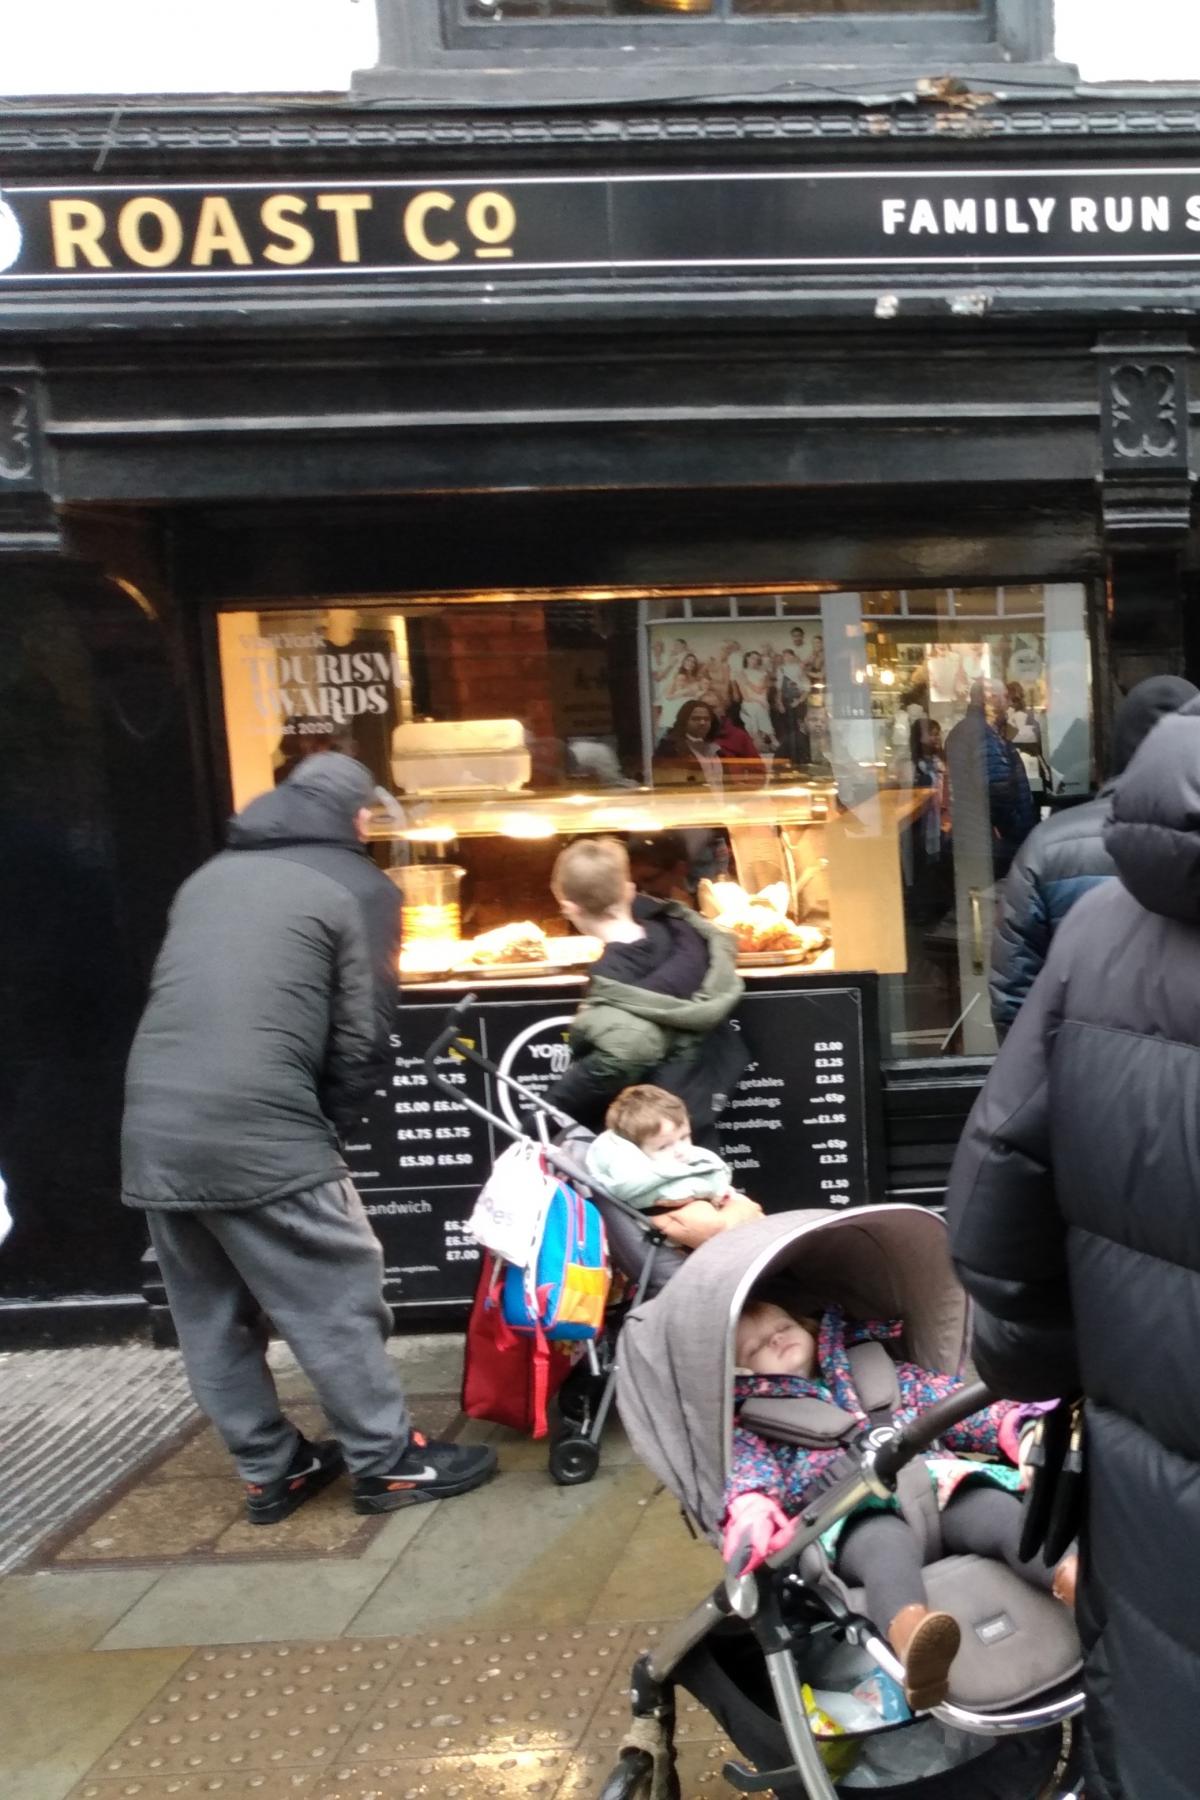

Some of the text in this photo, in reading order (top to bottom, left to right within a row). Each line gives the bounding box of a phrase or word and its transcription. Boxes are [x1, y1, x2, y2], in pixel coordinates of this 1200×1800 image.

[881, 197, 1056, 235] FAMILY
[1070, 195, 1170, 233] RUN
[49, 193, 374, 269] ROAST
[241, 652, 402, 689] TOURISM
[245, 684, 390, 725] AWARDS
[814, 1041, 844, 1052] £3.00
[815, 1057, 845, 1068] £3.25
[392, 1074, 429, 1087] £4.75
[816, 1074, 845, 1085] £2.85
[395, 1101, 431, 1114] £5.00
[732, 1096, 782, 1109] puddings
[733, 1118, 783, 1131] puddings
[397, 1127, 472, 1141] £4.75 £5.75
[725, 1144, 752, 1154] balls
[399, 1154, 474, 1168] £5.50 £6.50
[734, 1159, 760, 1169] balls
[819, 1154, 848, 1165] £3.25
[446, 1250, 480, 1261] £7.00
